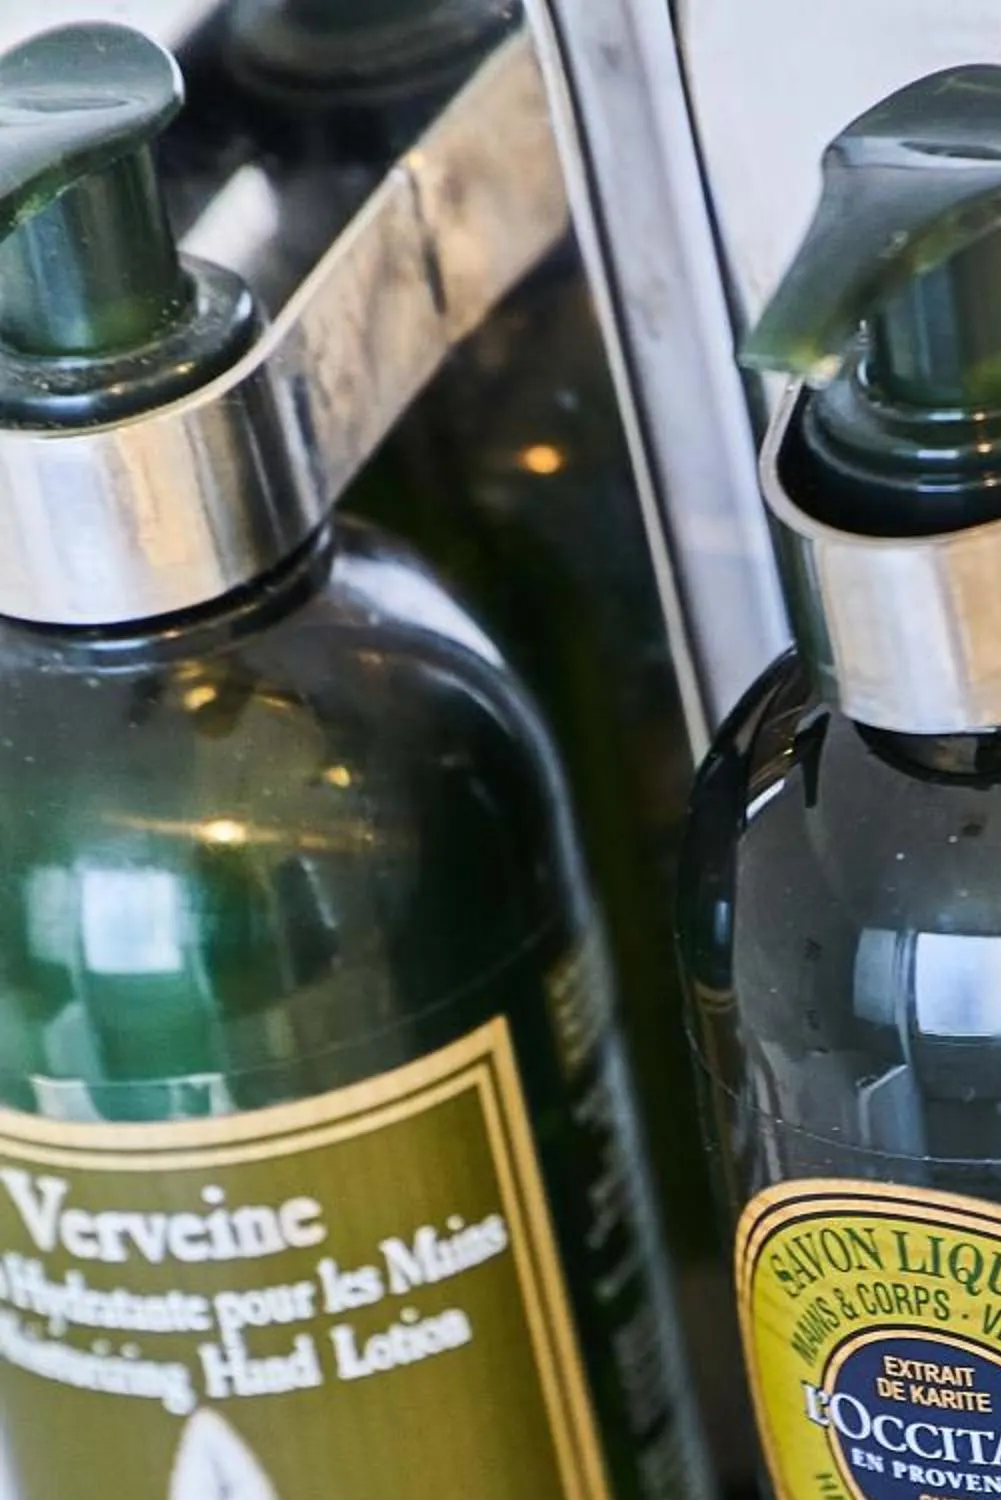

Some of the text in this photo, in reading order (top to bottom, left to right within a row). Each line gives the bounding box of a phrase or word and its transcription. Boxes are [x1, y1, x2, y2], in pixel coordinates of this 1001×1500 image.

[0, 1167, 327, 1263] Verveine
[213, 1280, 316, 1348] pour
[317, 1256, 384, 1314] les
[378, 1213, 508, 1295] Mains
[772, 1227, 881, 1300] SAVON
[199, 1332, 325, 1398] Hand
[330, 1307, 473, 1381] Lotion
[791, 1296, 842, 1368] MAINS
[842, 1287, 860, 1321] &
[862, 1282, 950, 1323] CORPS
[876, 1376, 993, 1413] DE KARITE
[883, 1355, 976, 1388] EXTRAIT
[851, 1447, 885, 1474] EN
